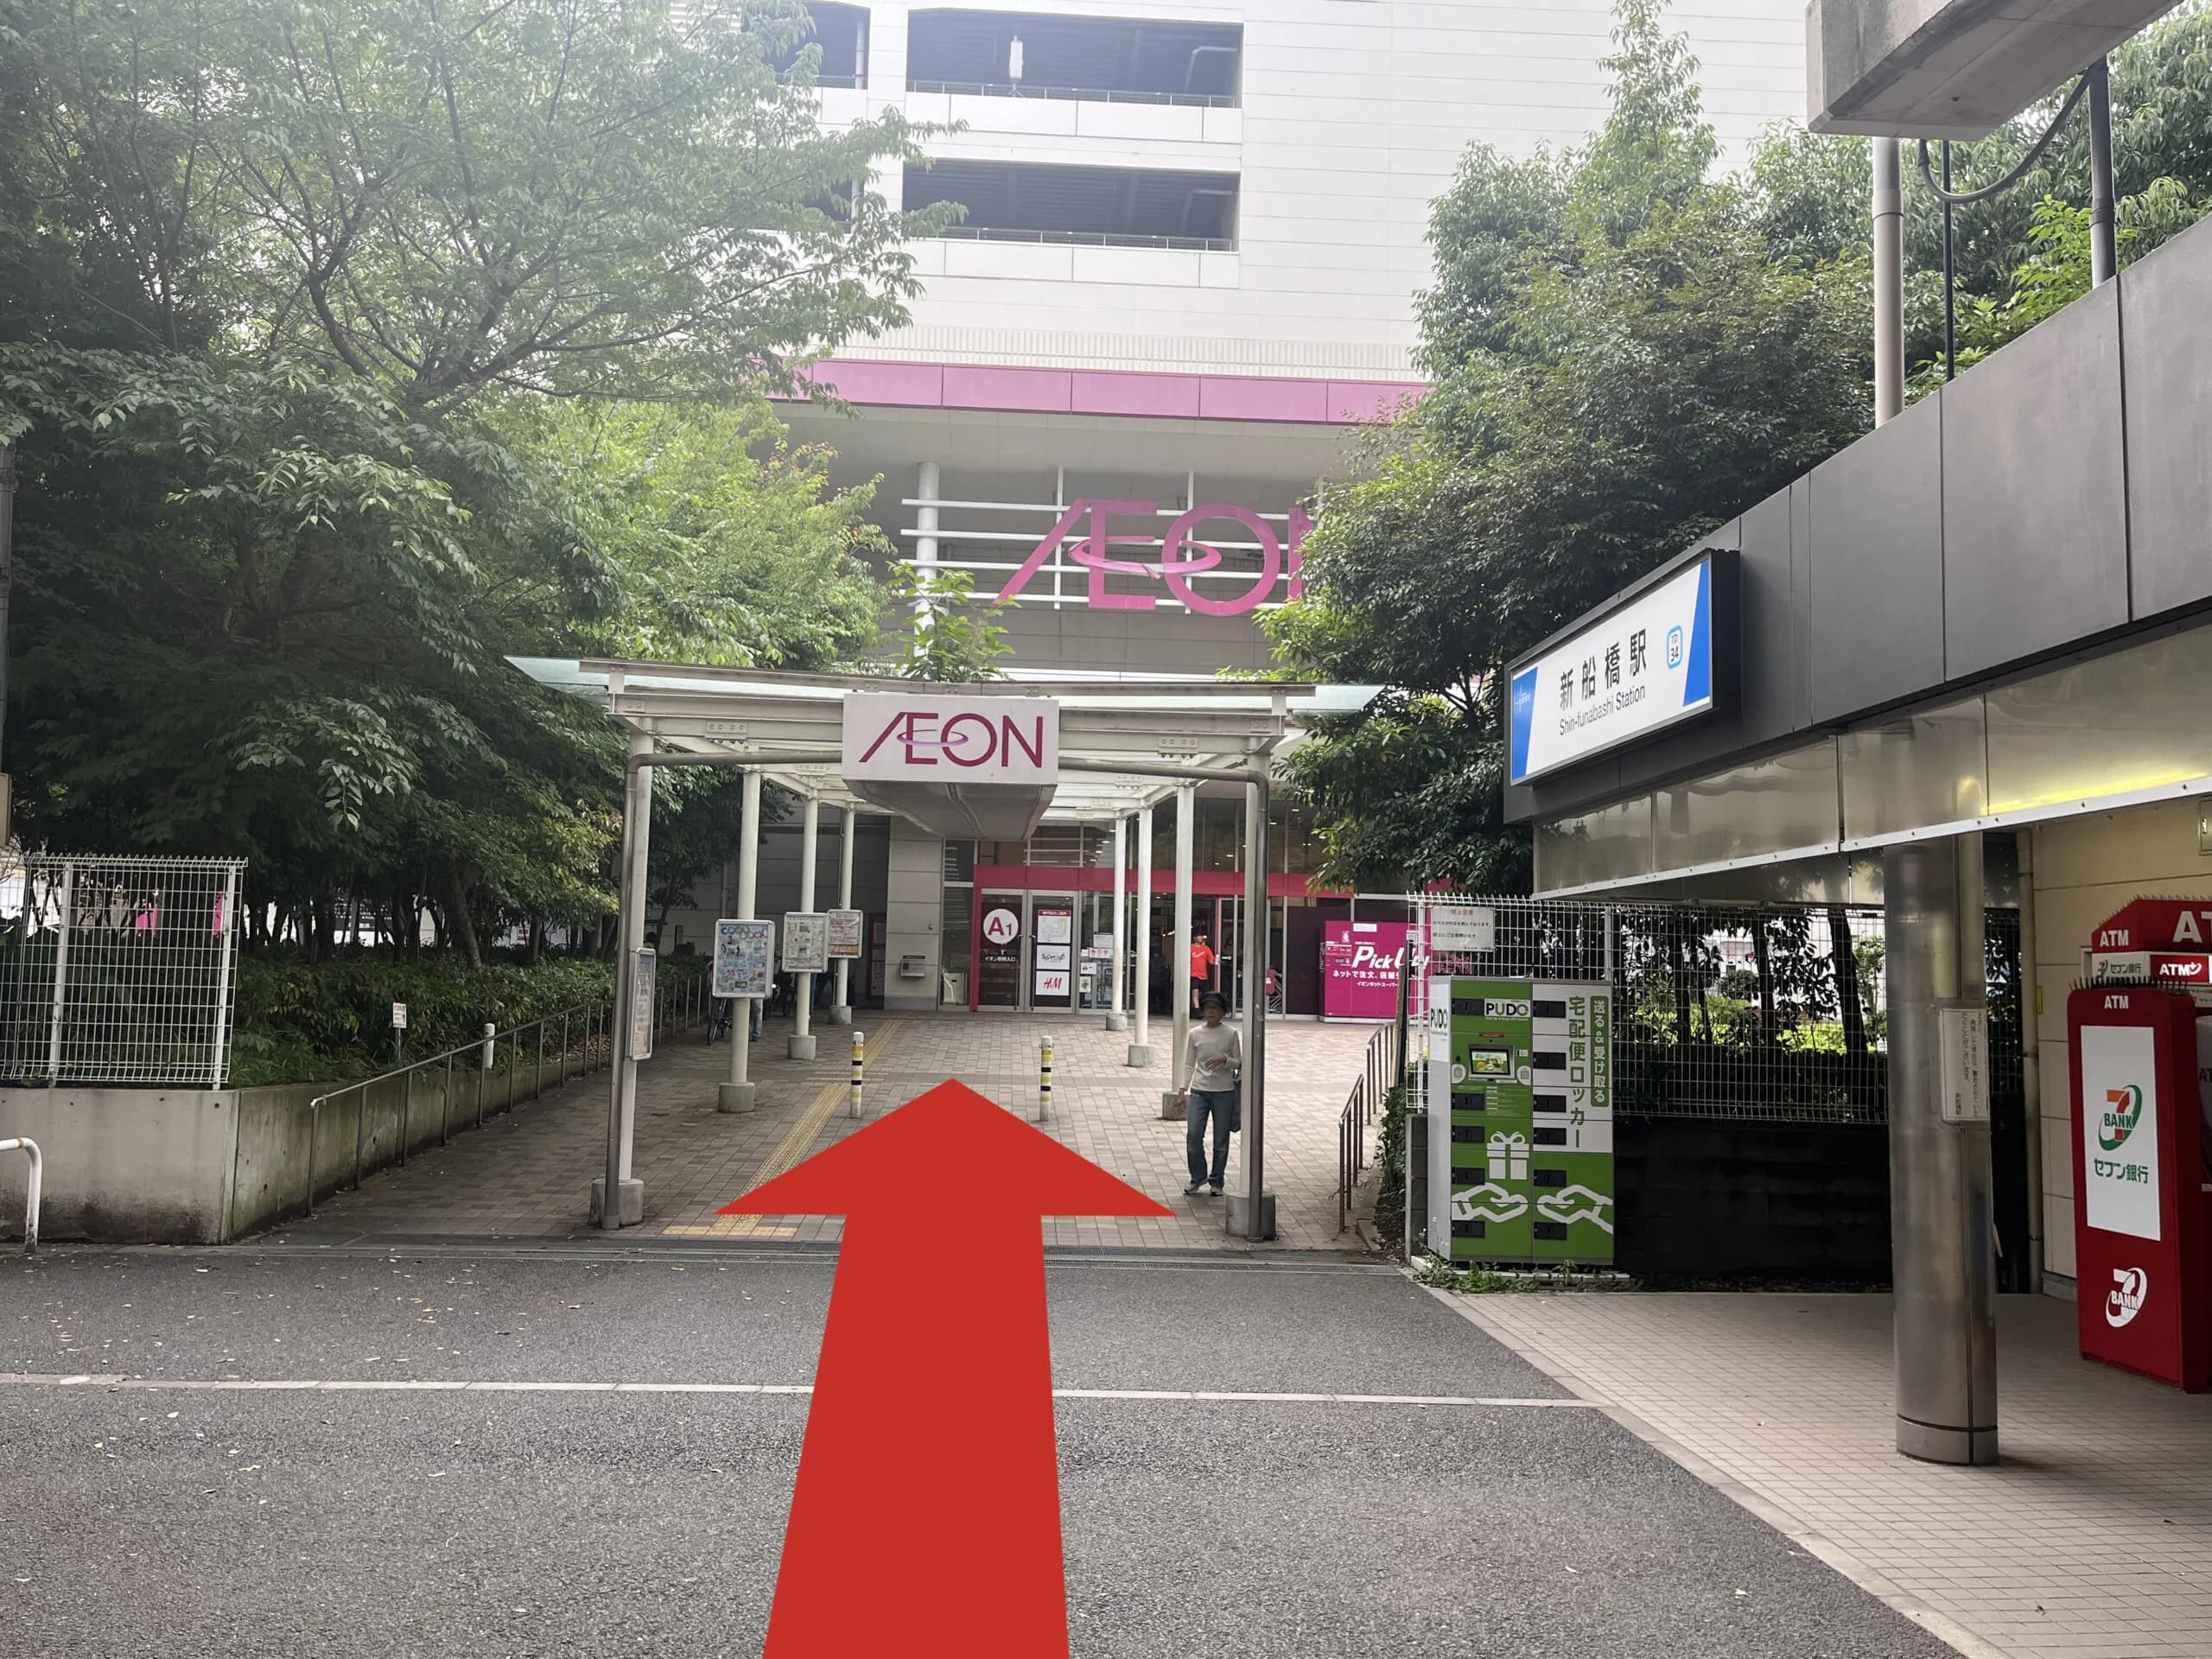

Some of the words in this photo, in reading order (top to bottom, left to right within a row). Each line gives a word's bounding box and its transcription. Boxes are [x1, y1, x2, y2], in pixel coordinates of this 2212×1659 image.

[1670, 645, 1679, 663] 34
[1559, 628, 1647, 711] 新船橋駅
[1560, 695, 1614, 736] Shin-funabashi
[1616, 685, 1645, 711] Station
[988, 916, 1013, 936] A1
[2099, 929, 2129, 948] ATM
[1351, 945, 1394, 969] Pick
[2159, 963, 2192, 976] ATM
[1485, 1002, 1529, 1016] PUDO
[2103, 995, 2129, 1009] ATM
[1430, 1007, 1448, 1029] PUDO
[1568, 995, 1586, 1148] 宅配便ロッカー
[2103, 1112, 2133, 1129] BANK
[2094, 1157, 2149, 1184] セブン銀行
[2110, 1289, 2139, 1309] BANK
